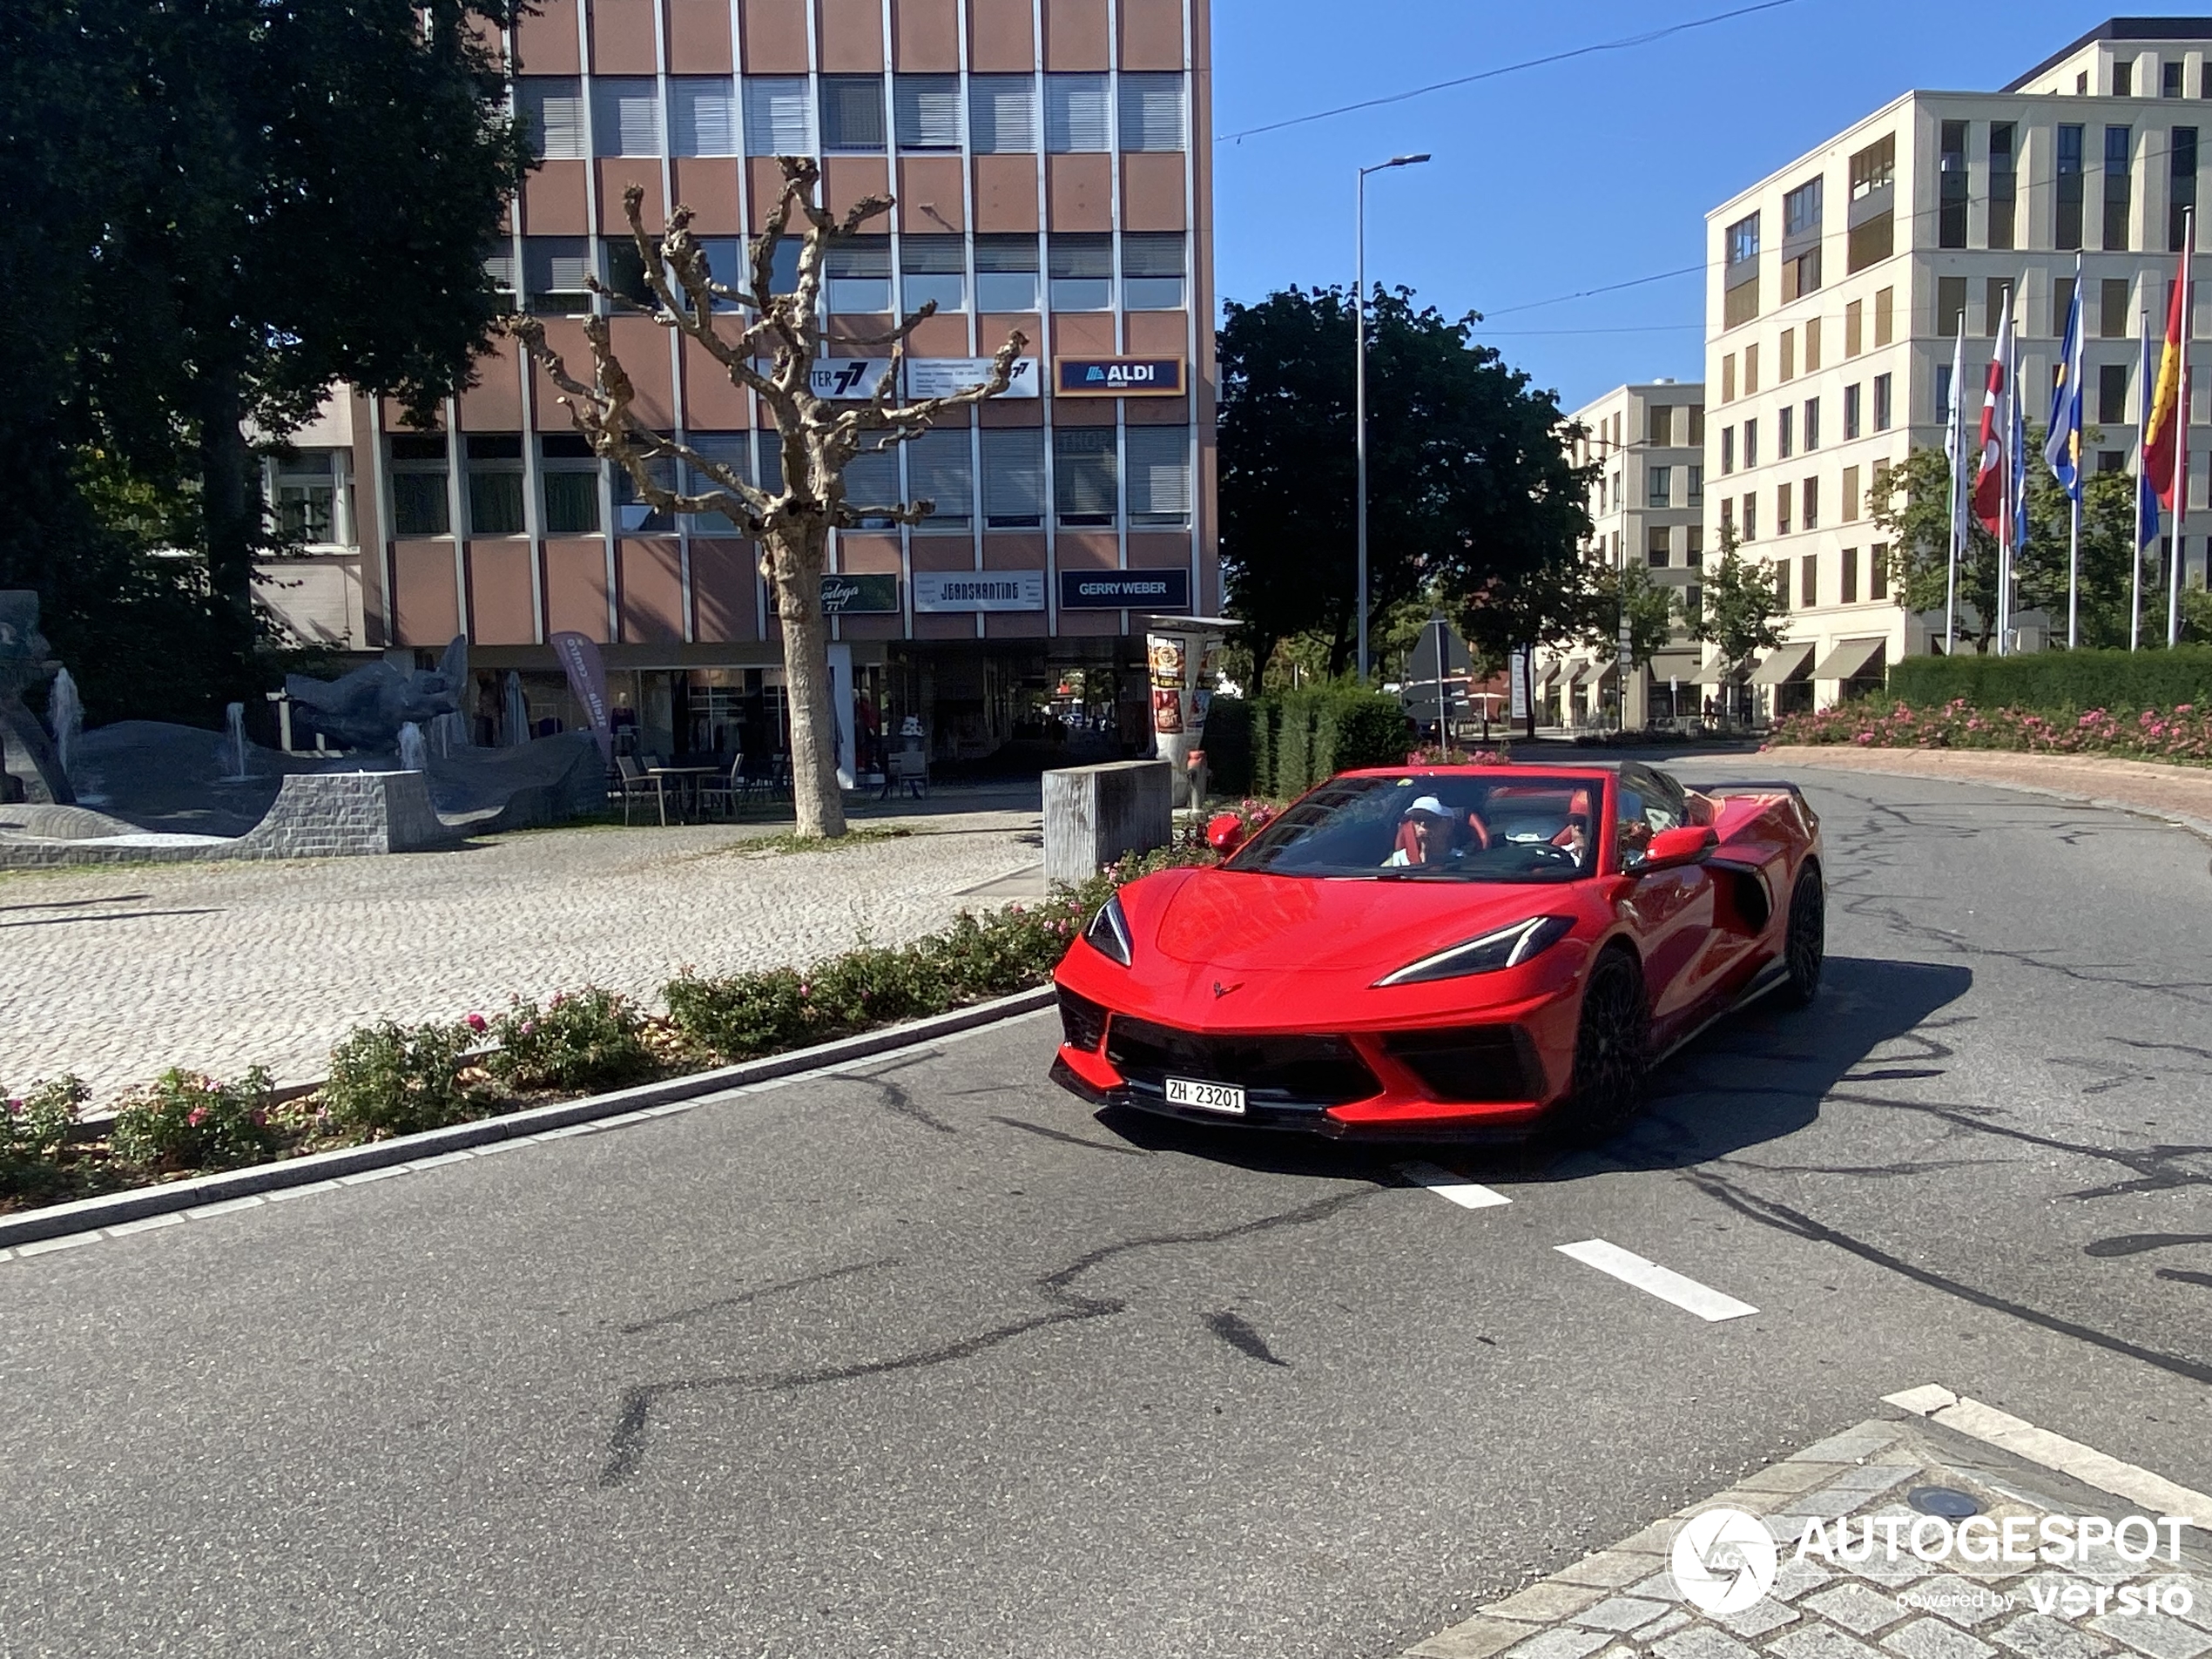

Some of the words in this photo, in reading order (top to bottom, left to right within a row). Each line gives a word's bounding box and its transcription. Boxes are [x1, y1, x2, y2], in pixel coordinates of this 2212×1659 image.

[811, 371, 832, 387] TER
[833, 361, 868, 395] 77
[1107, 365, 1154, 381] ALDI
[820, 583, 860, 607] odega
[1079, 583, 1122, 595] GERRY
[1123, 582, 1167, 594] WEBER
[1170, 1082, 1187, 1100] ZH
[1196, 1086, 1241, 1109] 23201
